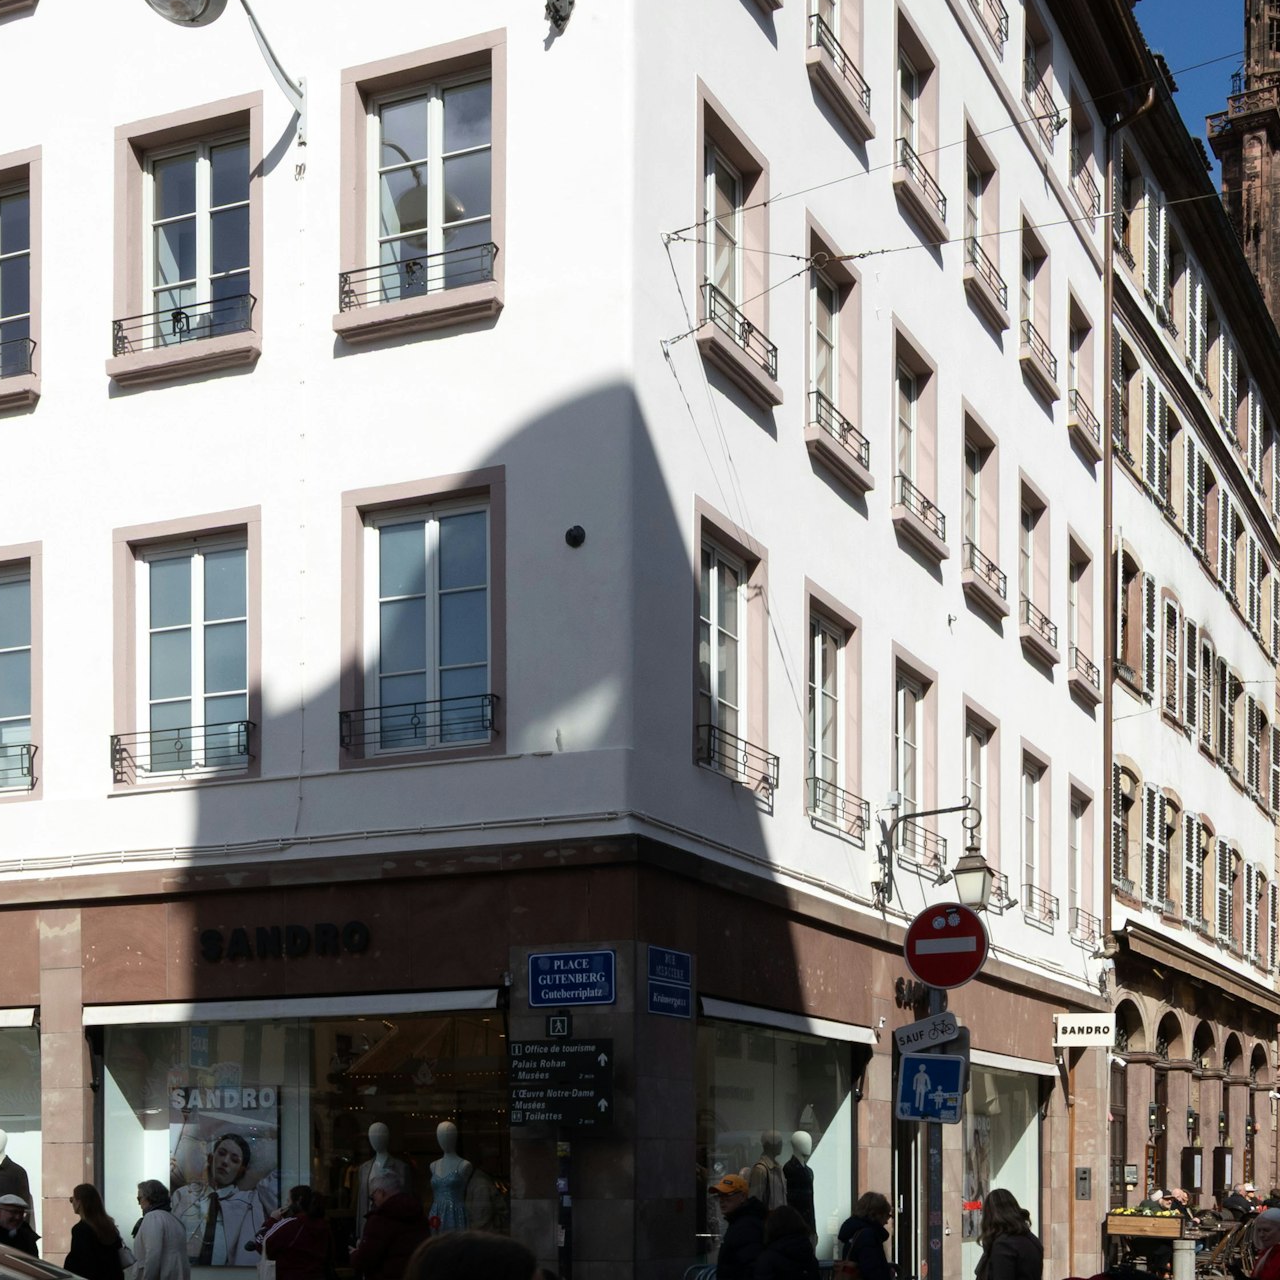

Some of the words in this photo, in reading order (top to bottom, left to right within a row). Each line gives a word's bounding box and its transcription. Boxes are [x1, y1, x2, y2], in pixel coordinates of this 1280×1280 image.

[200, 921, 370, 963] SANDRO
[553, 958, 590, 970] PLACE
[538, 972, 605, 985] GUTENBERG
[1061, 1025, 1110, 1035] SANDRO
[899, 1030, 925, 1046] SAUF
[525, 1045, 548, 1054] Office
[550, 1045, 560, 1053] de
[562, 1043, 596, 1053] tourisme
[512, 1060, 537, 1068] Palais
[540, 1059, 566, 1067] Rohan
[171, 1087, 276, 1109] SANDRO
[512, 1089, 545, 1099] L'Œuvre
[547, 1088, 595, 1098] Notre-Dame
[525, 1111, 563, 1121] Toilettes
